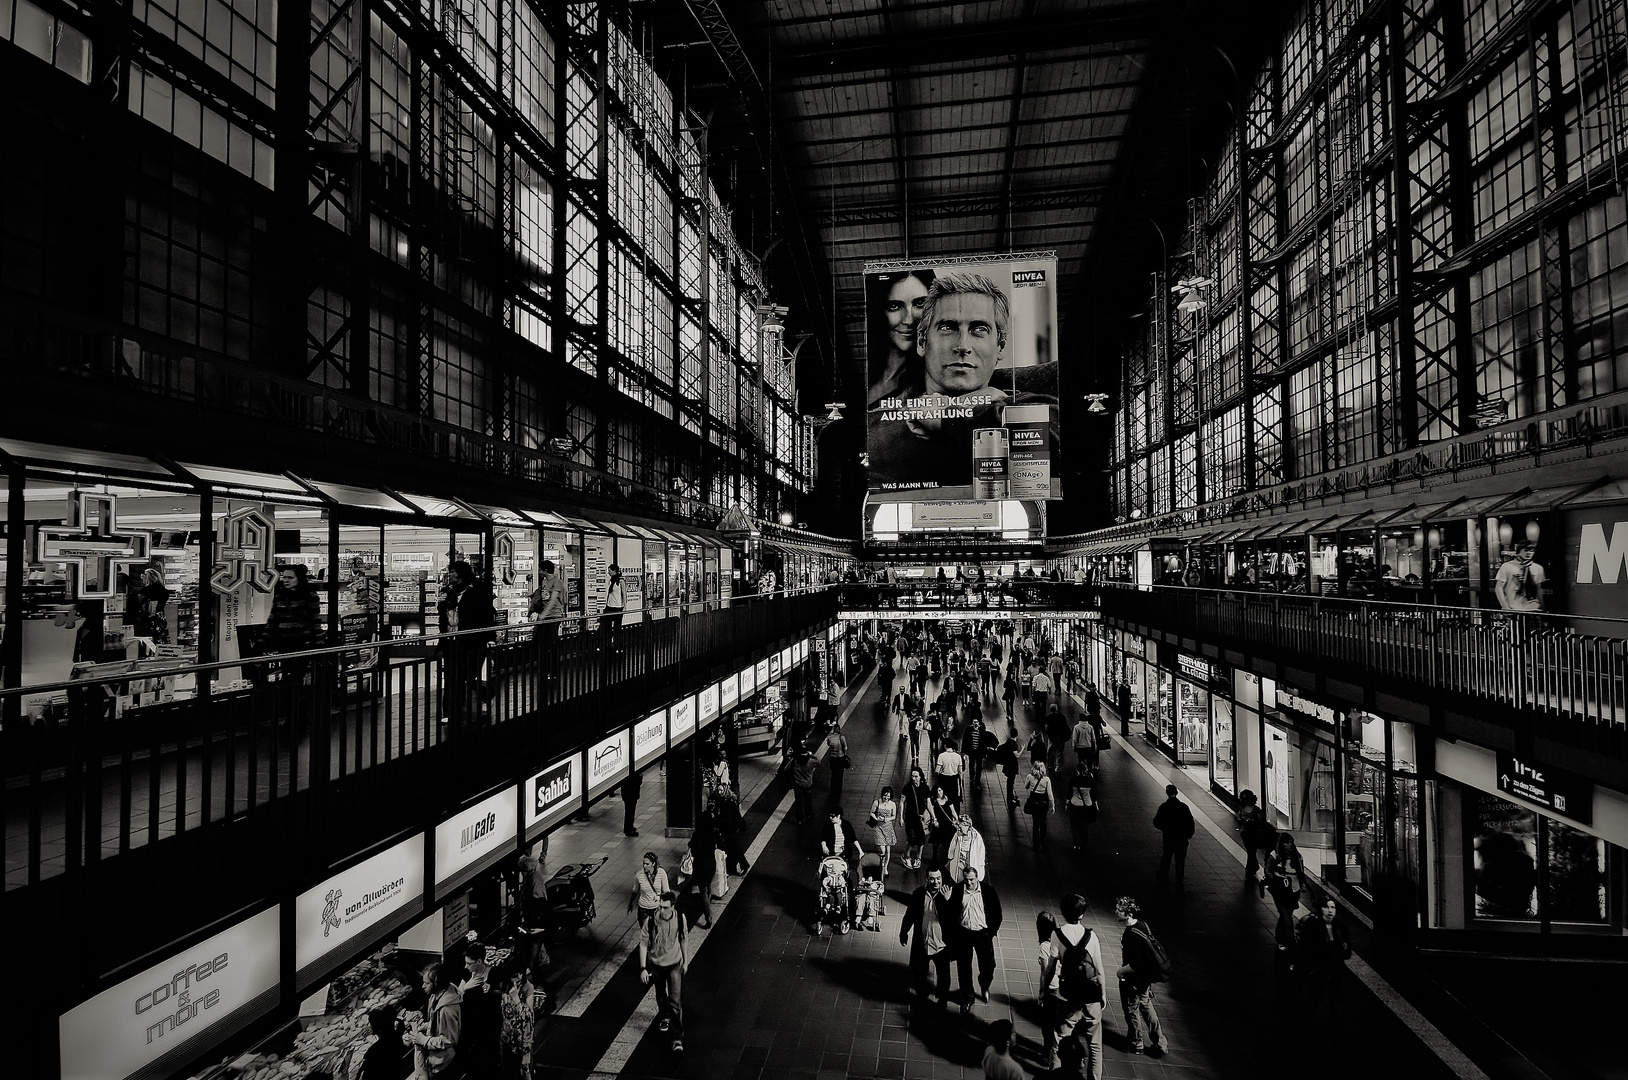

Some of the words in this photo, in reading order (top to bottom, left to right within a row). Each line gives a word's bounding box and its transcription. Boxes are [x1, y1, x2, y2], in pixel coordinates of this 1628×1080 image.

[1014, 272, 1043, 281] NIVEA
[880, 397, 903, 409] FÜR
[906, 398, 933, 408] EINE
[936, 397, 945, 407] 1.
[949, 395, 992, 406] KLASSE
[880, 408, 974, 421] AUSSTRAHLUNG
[882, 482, 897, 490] WAS
[898, 481, 921, 489] MANN
[922, 481, 940, 489] WILL
[1040, 611, 1079, 619] McDonald's
[1276, 689, 1293, 708] THE
[1292, 696, 1318, 717] BODY
[345, 901, 362, 916] von
[362, 877, 404, 907] Allwörden
[135, 952, 229, 1016] coffee
[177, 989, 192, 1008] &
[146, 987, 221, 1045] more
